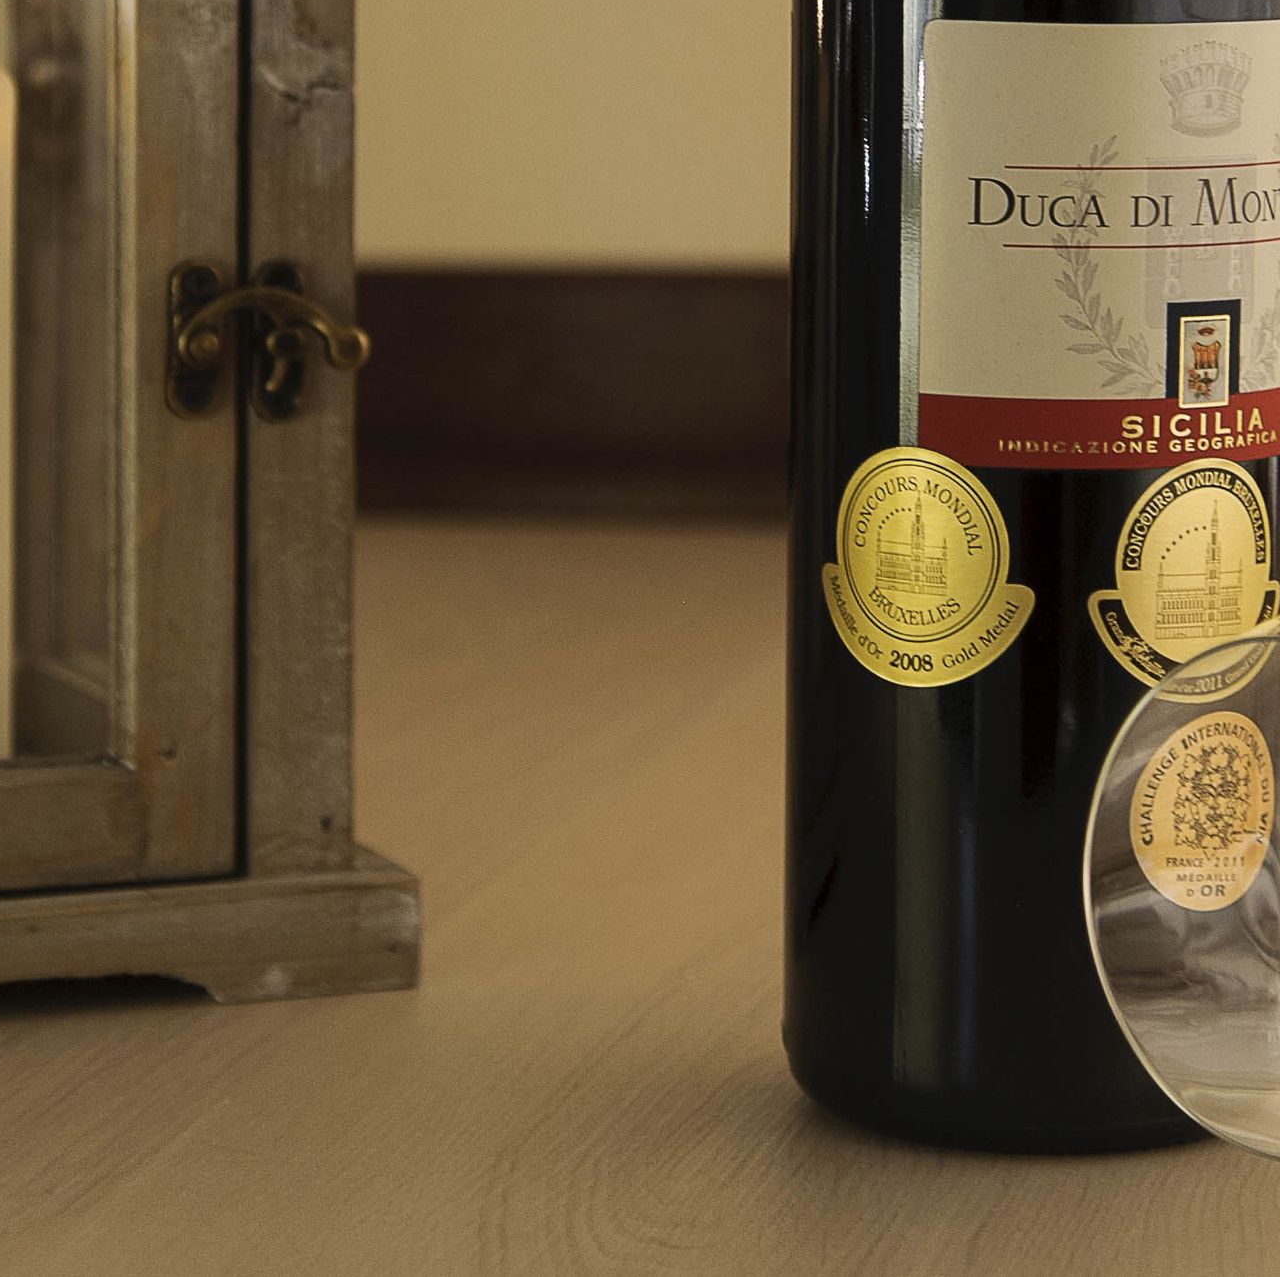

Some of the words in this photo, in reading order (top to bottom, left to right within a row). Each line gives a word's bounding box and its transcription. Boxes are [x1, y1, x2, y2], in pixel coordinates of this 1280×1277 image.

[999, 438, 1158, 454] INDICAZIONE
[1169, 428, 1277, 453] GEOGRAFICA
[1121, 408, 1264, 439] SICILIA
[854, 476, 918, 548] CONCOURS
[923, 480, 983, 556] MONDIAL
[1125, 490, 1174, 569] CONCOURS
[1174, 471, 1233, 496] MONDIAL
[868, 586, 961, 626] BRUXELLES
[889, 650, 934, 672] 2008
[942, 644, 980, 669] Gold
[979, 600, 1021, 647] Medal
[1140, 748, 1180, 846] CHALLENGE
[1255, 813, 1270, 844] VIN
[1166, 856, 1203, 868] FRANCE
